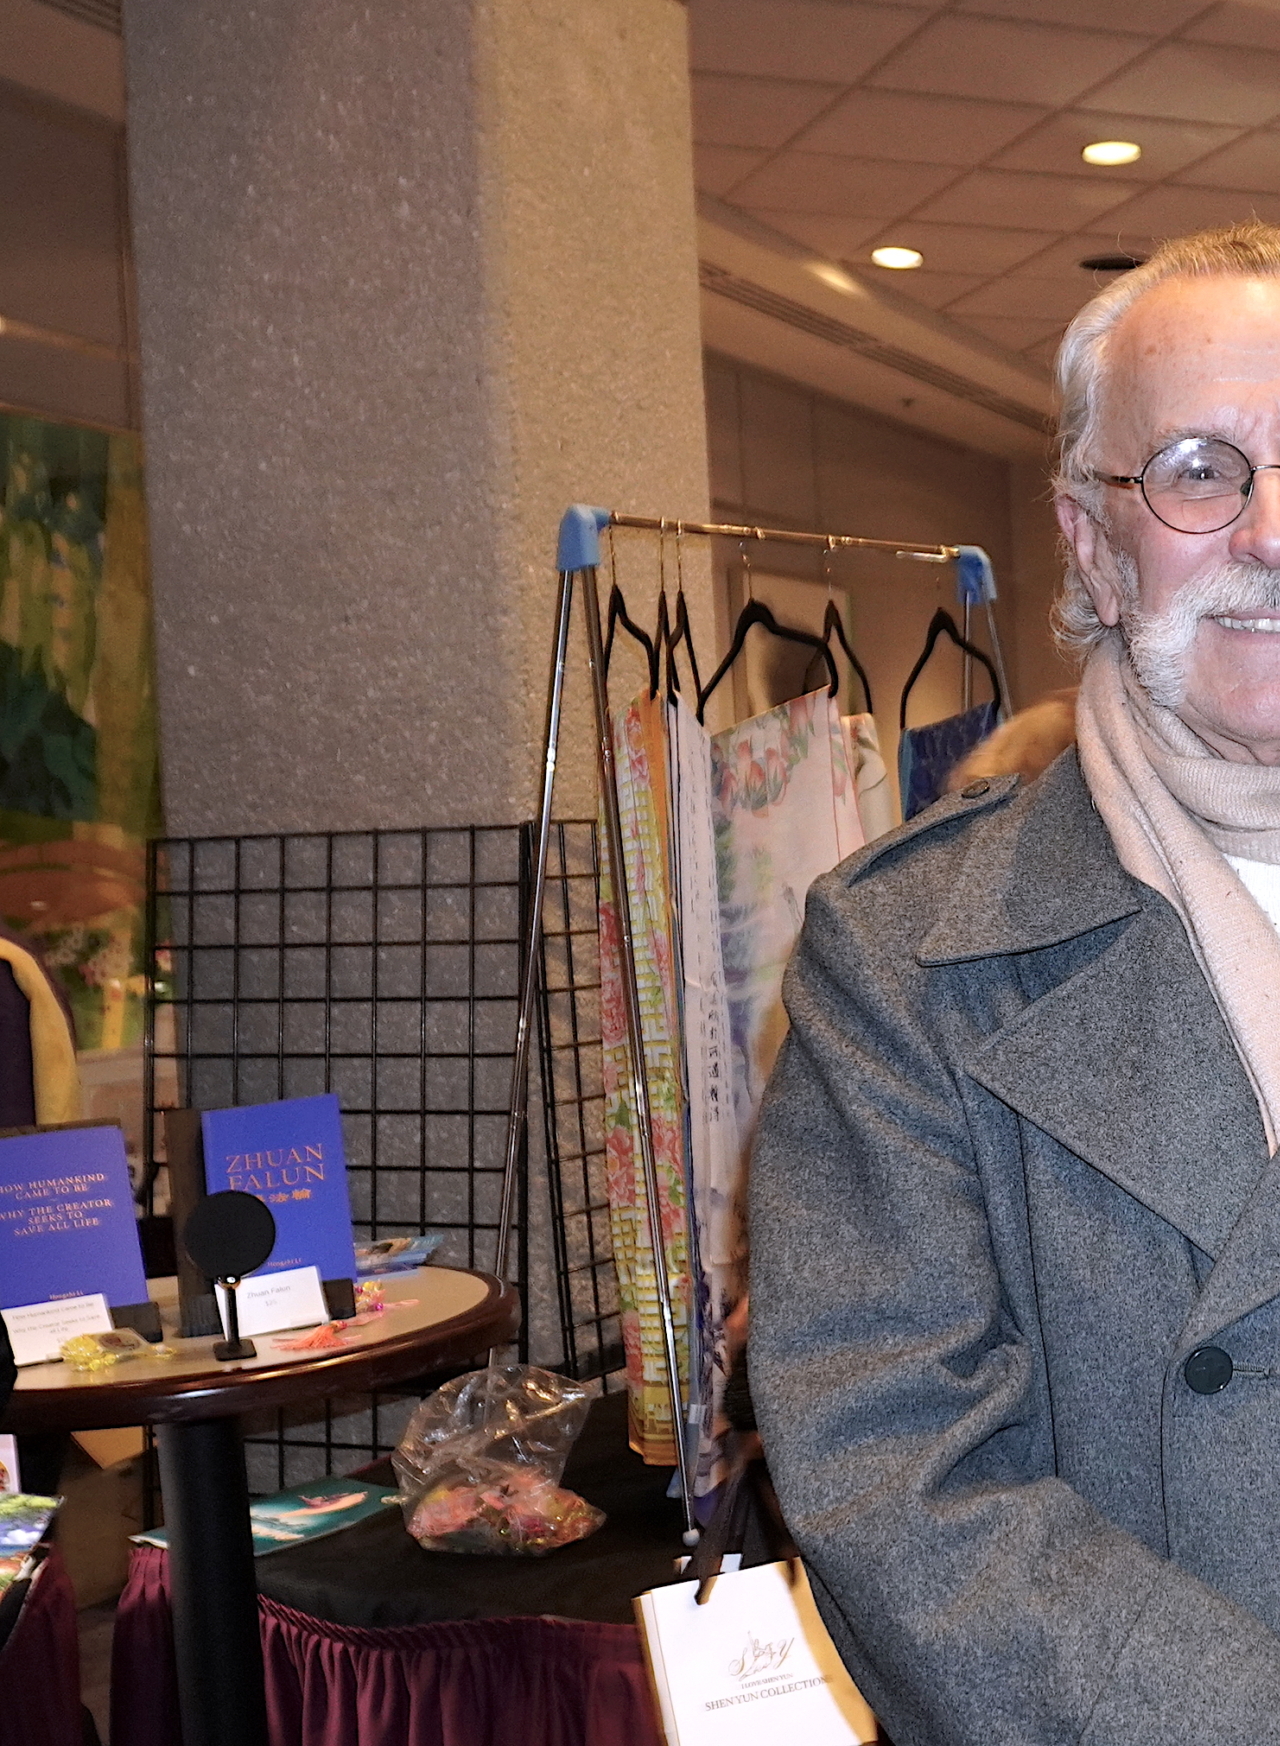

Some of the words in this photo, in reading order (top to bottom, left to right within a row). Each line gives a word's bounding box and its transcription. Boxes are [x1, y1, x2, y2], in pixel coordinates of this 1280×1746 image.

[225, 1143, 323, 1173] ZHUAN
[28, 1173, 105, 1189] HUMANKIND
[228, 1163, 325, 1191] FALUN
[15, 1188, 50, 1200] CAME
[54, 1185, 69, 1195] TO
[74, 1183, 89, 1192] BE
[29, 1205, 53, 1216] THE
[56, 1198, 112, 1212] CREATOR
[14, 1225, 44, 1236] SAVE
[48, 1221, 70, 1232] ALL
[73, 1217, 99, 1228] LIFE
[28, 1213, 63, 1225] SEEKS
[67, 1210, 83, 1220] TO
[247, 1288, 270, 1299] Zhuan
[270, 1285, 291, 1295] Falun
[705, 1697, 734, 1711] SHEN
[734, 1690, 759, 1704] YUN
